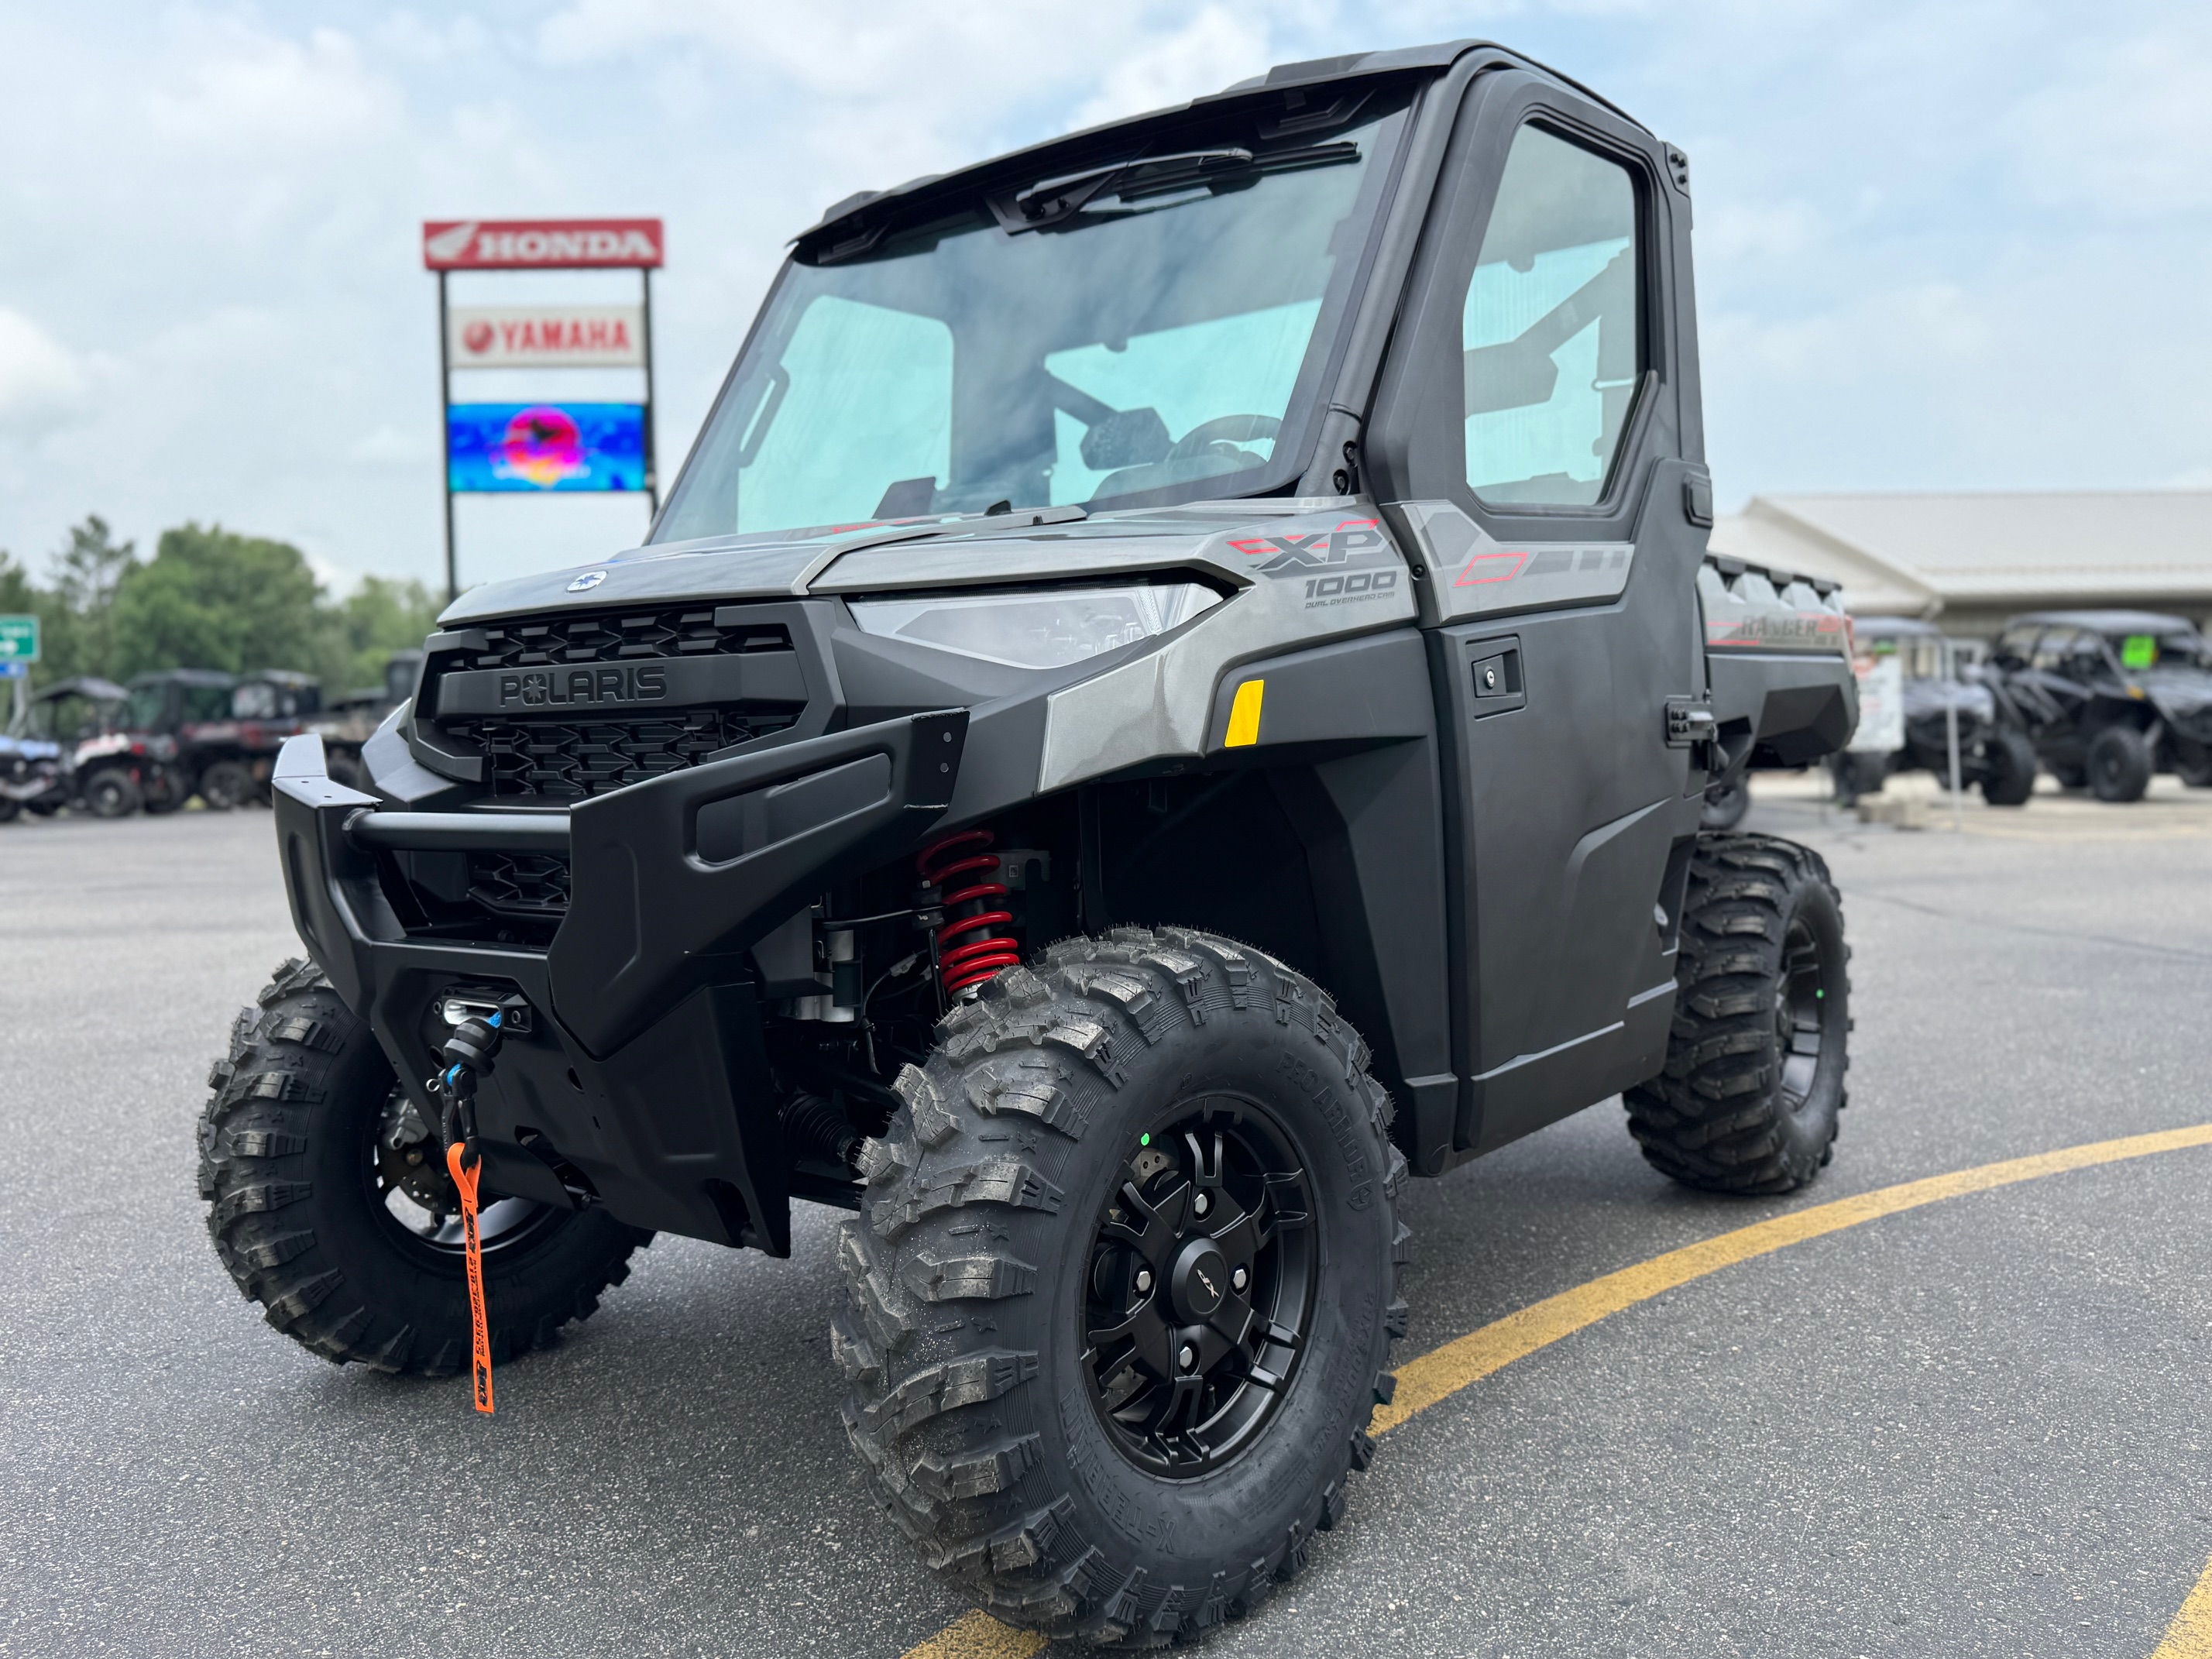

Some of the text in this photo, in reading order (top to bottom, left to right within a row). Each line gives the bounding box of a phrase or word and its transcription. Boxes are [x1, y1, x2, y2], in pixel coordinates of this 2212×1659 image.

[479, 232, 654, 259] HONDA
[502, 320, 630, 349] YAMAHA
[1305, 571, 1397, 599] 1000
[1305, 591, 1395, 610] DUAL OVERHEAD CAM
[1740, 616, 1816, 637] RANGER
[500, 666, 667, 708] POLARIS
[1275, 1051, 1365, 1183] PRO ARMOR
